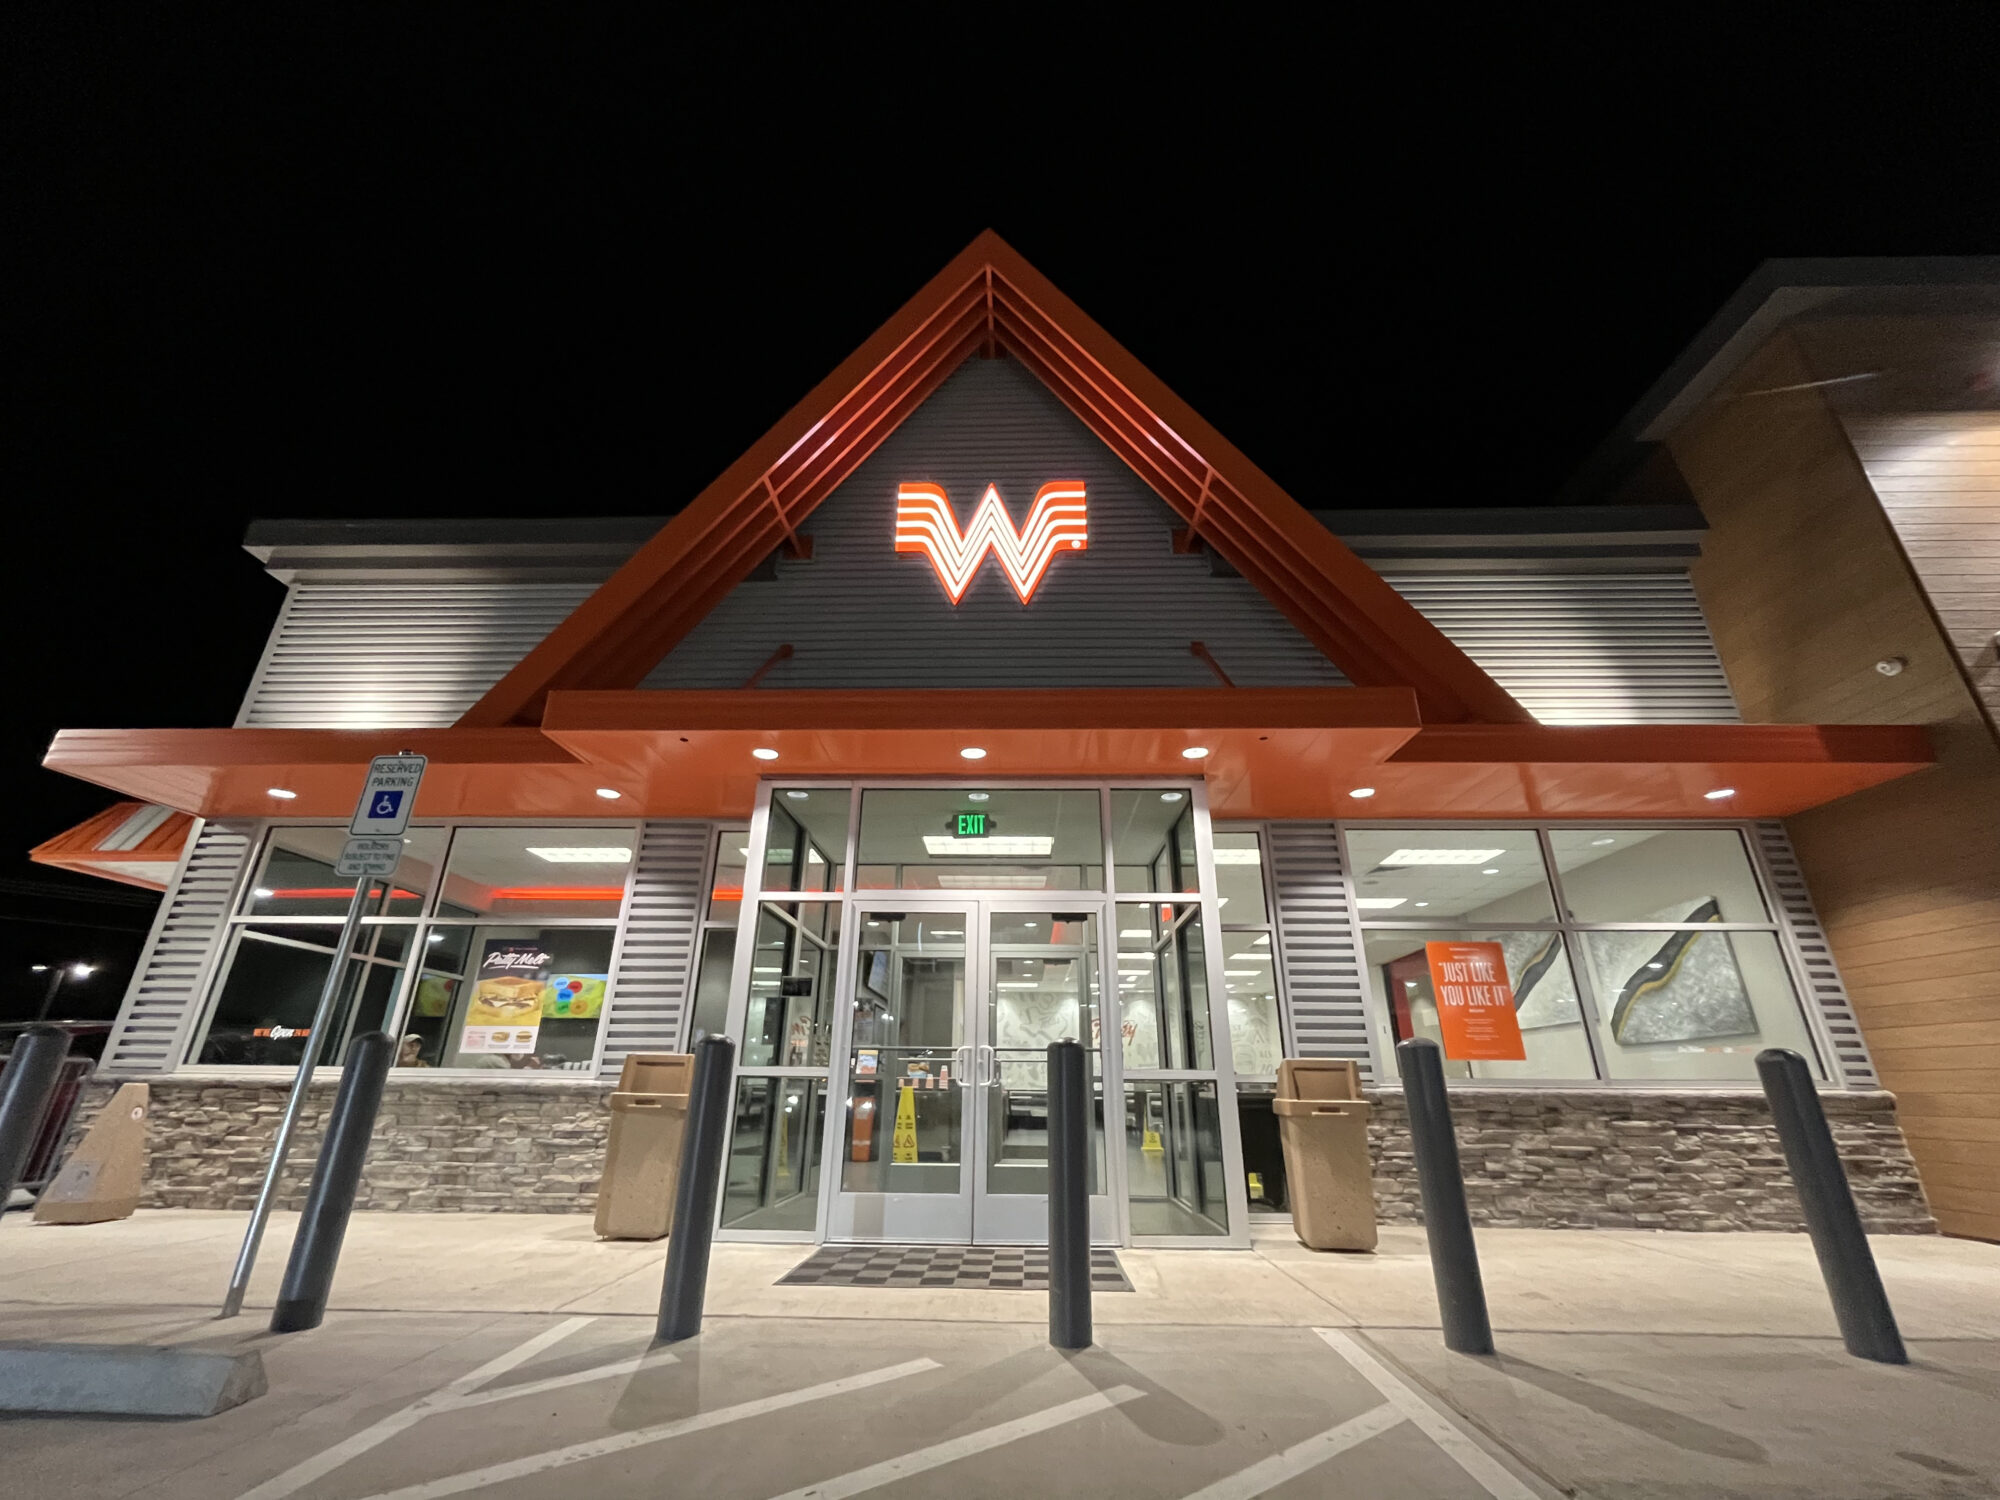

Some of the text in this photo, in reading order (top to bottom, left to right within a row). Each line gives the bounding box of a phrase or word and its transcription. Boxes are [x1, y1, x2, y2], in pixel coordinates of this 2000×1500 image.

[895, 481, 1087, 605] W
[373, 763, 421, 773] RESERVED
[371, 777, 413, 787] PARKING
[958, 814, 985, 835] EXIT
[483, 951, 550, 969] Patty Melt
[1470, 961, 1496, 983] LIKE
[1440, 985, 1465, 1006] YOU
[1466, 985, 1493, 1006] LIKE
[270, 1025, 295, 1040] Open
